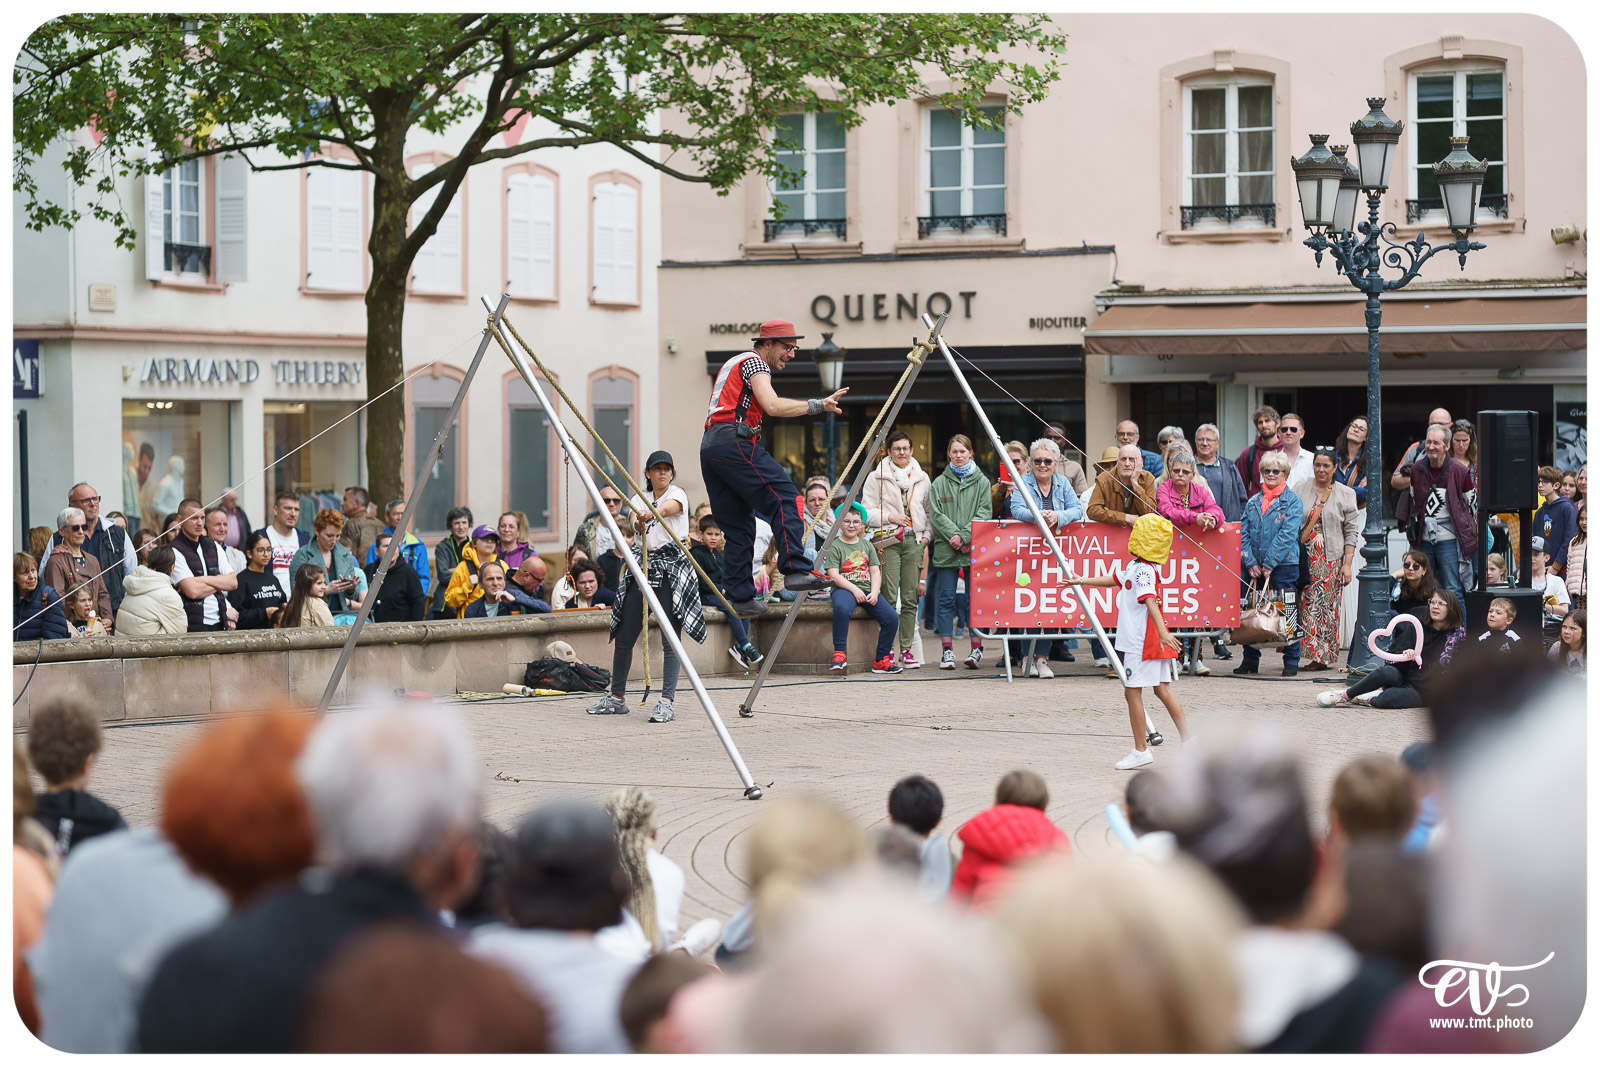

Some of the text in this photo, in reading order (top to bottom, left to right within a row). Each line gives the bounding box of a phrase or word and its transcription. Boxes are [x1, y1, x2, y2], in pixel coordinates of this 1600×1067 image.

[810, 291, 977, 327] QUENOT
[1029, 316, 1087, 331] BIJOUTIER
[140, 357, 364, 385] ARMAND THIERY
[1016, 535, 1115, 555] FESTIVAL
[1015, 558, 1200, 585] L'HUMUR
[1014, 587, 1078, 614] DES
